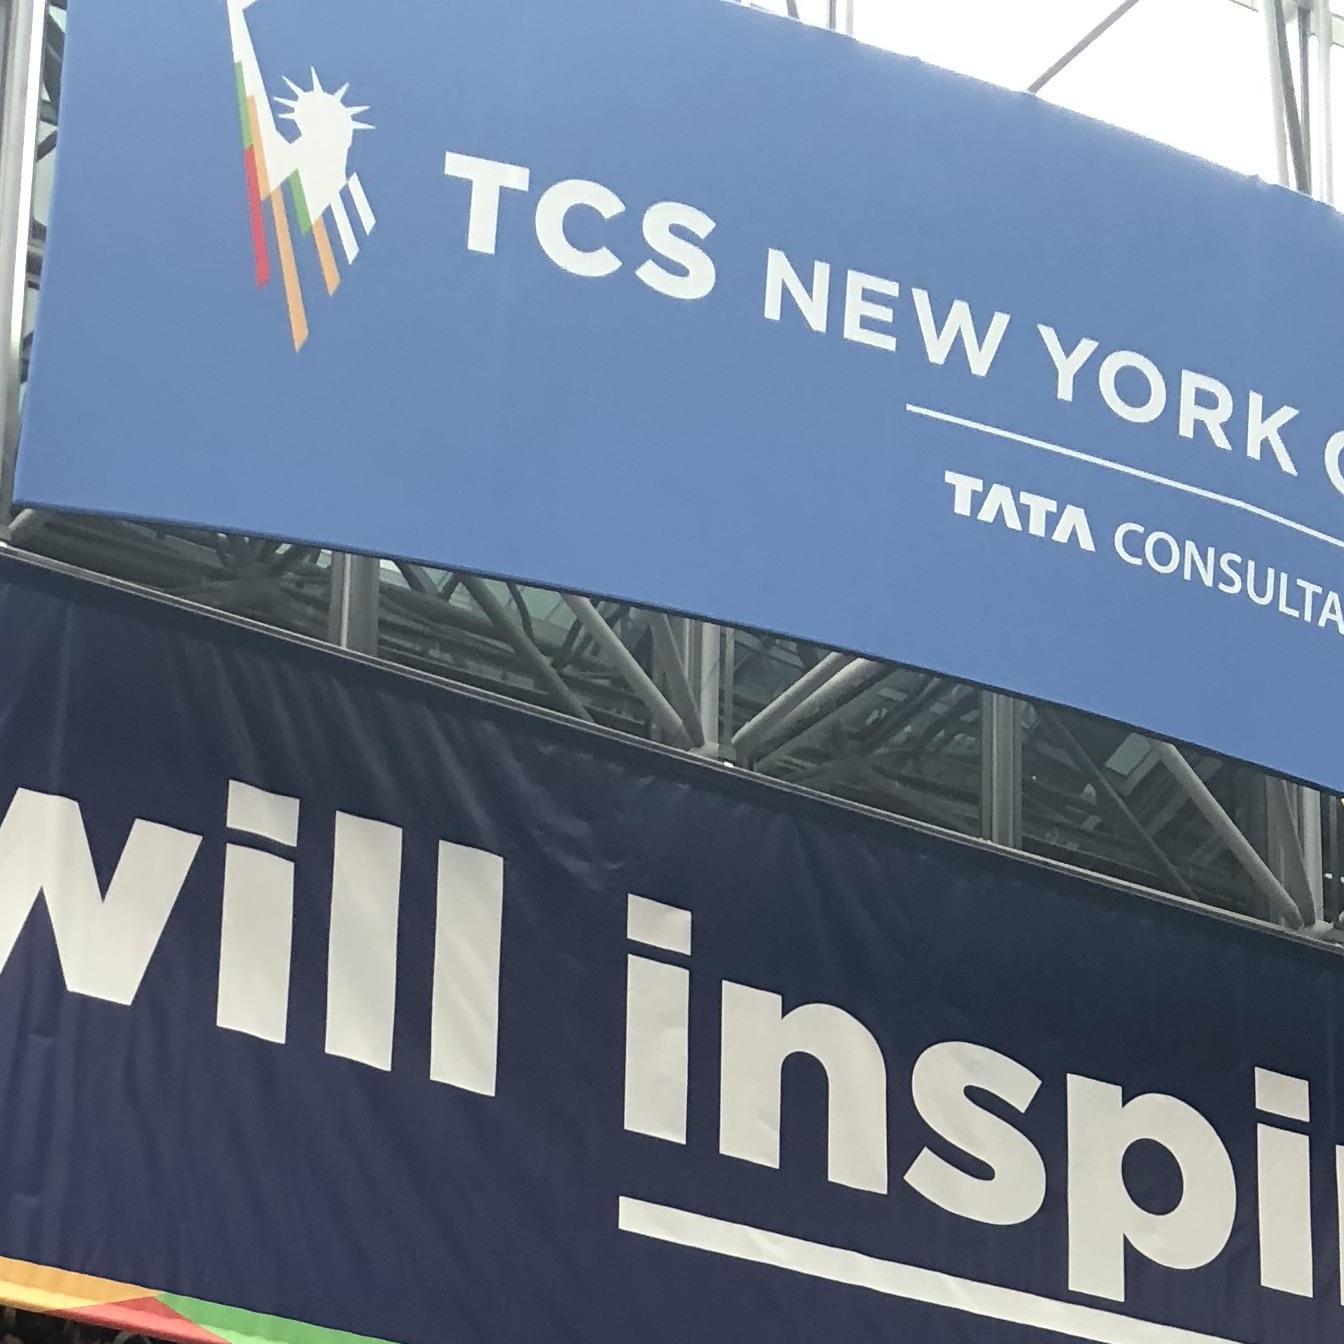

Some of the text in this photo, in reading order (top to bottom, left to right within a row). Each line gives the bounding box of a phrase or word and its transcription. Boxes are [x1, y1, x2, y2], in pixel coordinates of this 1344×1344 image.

[443, 150, 717, 301] TCS
[763, 247, 1011, 378] NEW
[1037, 323, 1300, 477] YORK
[944, 470, 1096, 553] TATA
